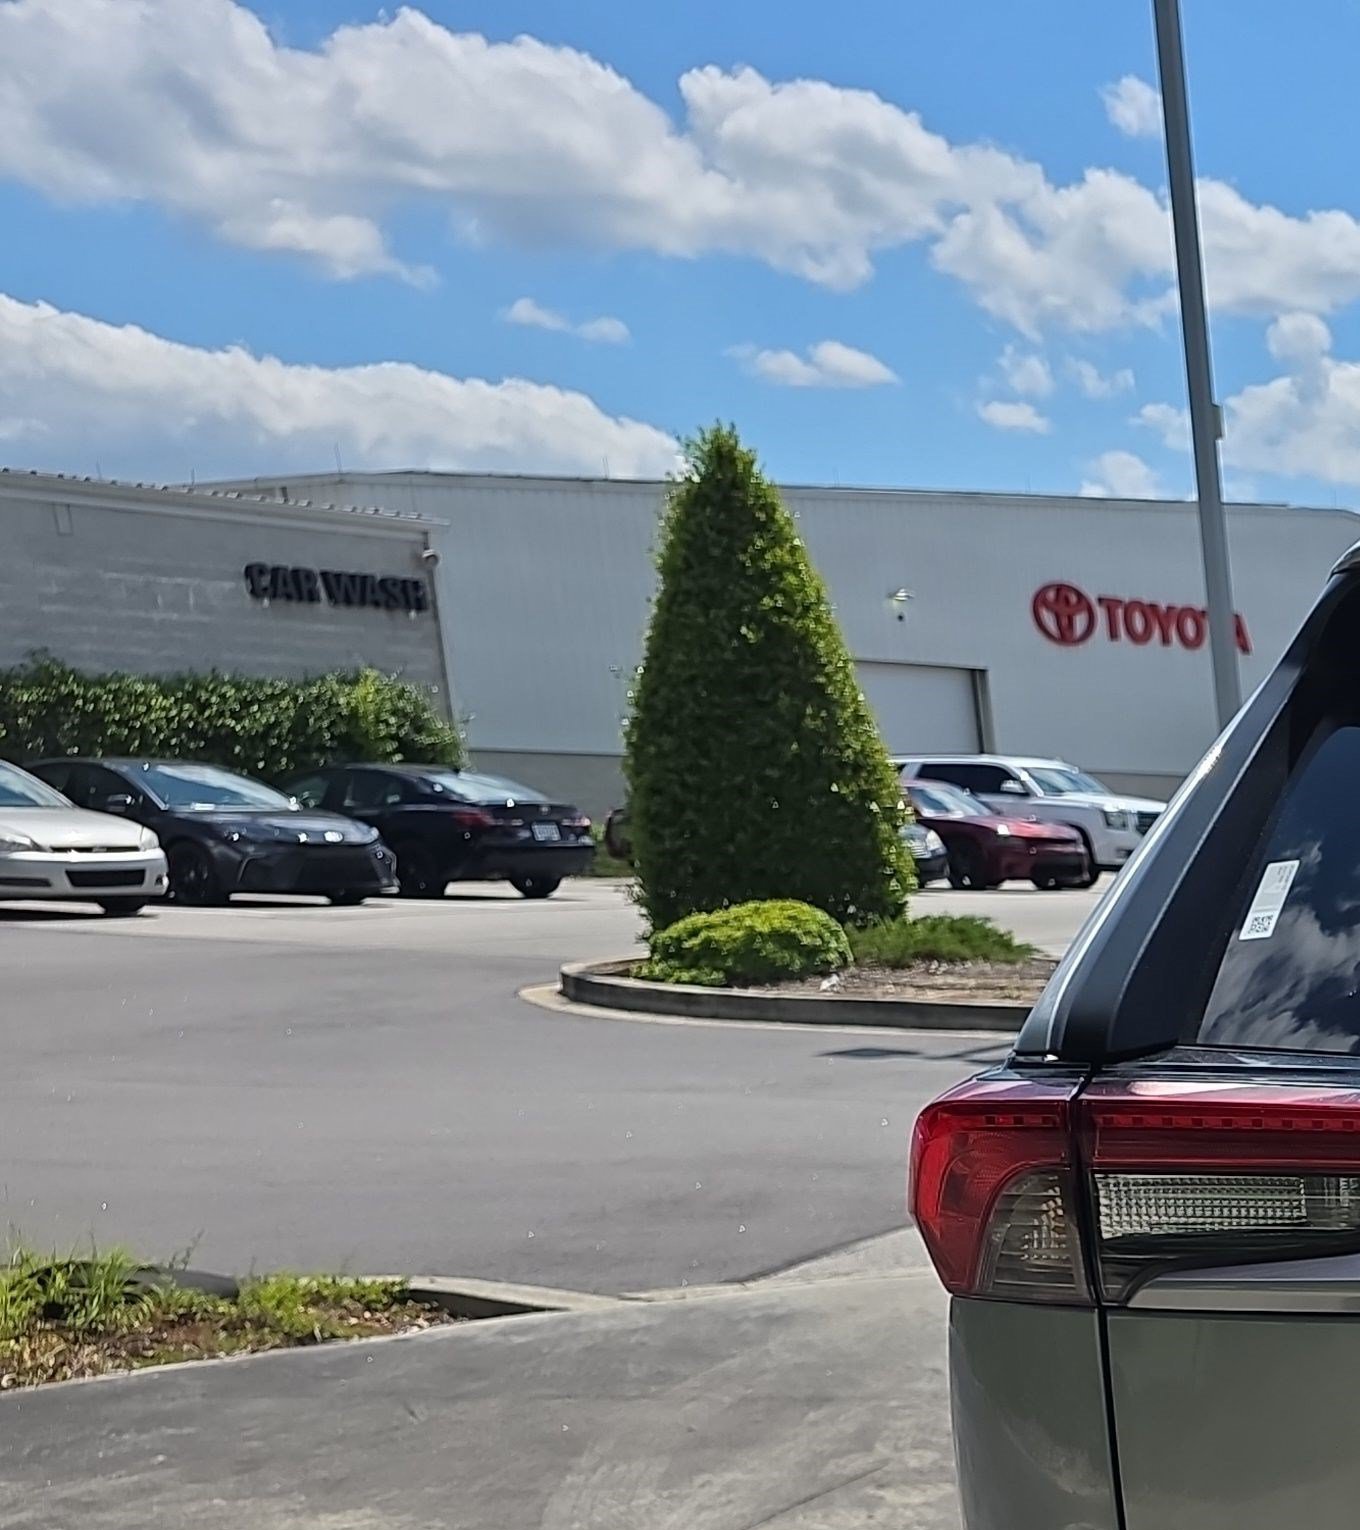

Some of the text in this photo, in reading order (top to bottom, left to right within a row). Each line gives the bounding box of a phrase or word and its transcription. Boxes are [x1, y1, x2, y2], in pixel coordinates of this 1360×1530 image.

[245, 563, 429, 611] CAR WASH
[1097, 597, 1252, 654] TOYO
